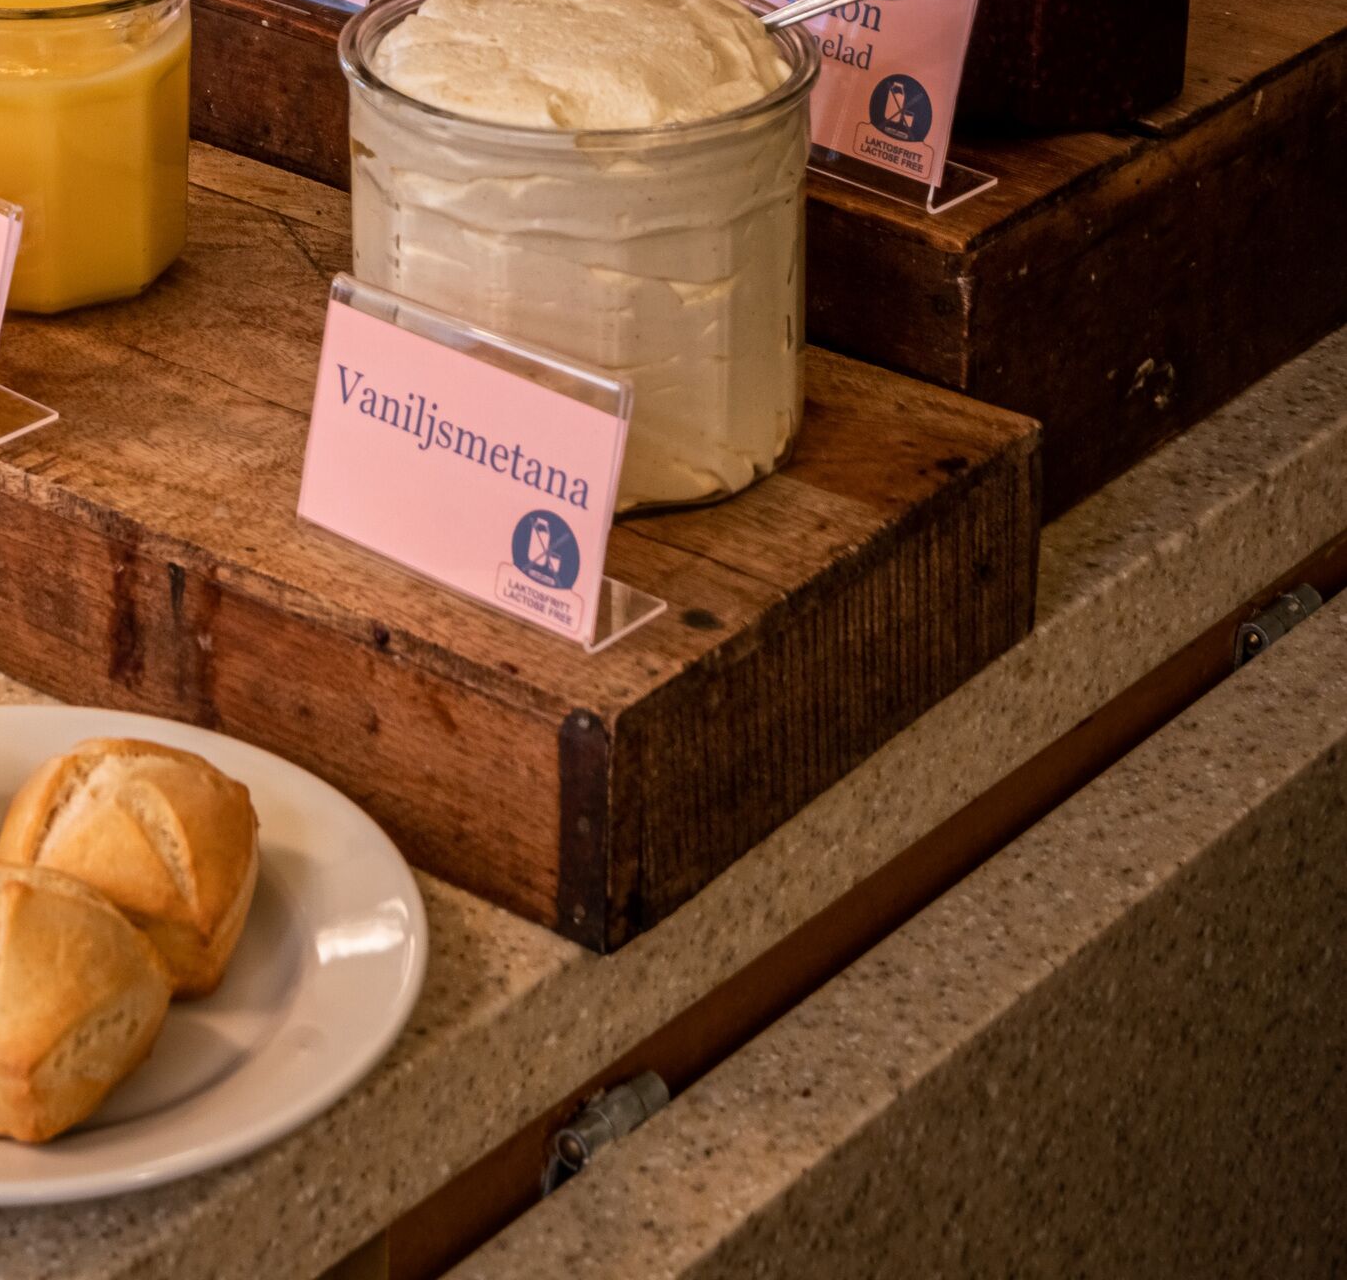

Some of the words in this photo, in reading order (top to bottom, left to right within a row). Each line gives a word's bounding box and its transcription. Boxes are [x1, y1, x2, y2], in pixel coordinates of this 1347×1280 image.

[860, 143, 900, 165] LACTOSE
[900, 155, 925, 173] FREE
[865, 135, 923, 161] LAKTOSFRITT
[336, 363, 590, 510] Vaniljsmetana
[503, 590, 545, 615] LACTOSE
